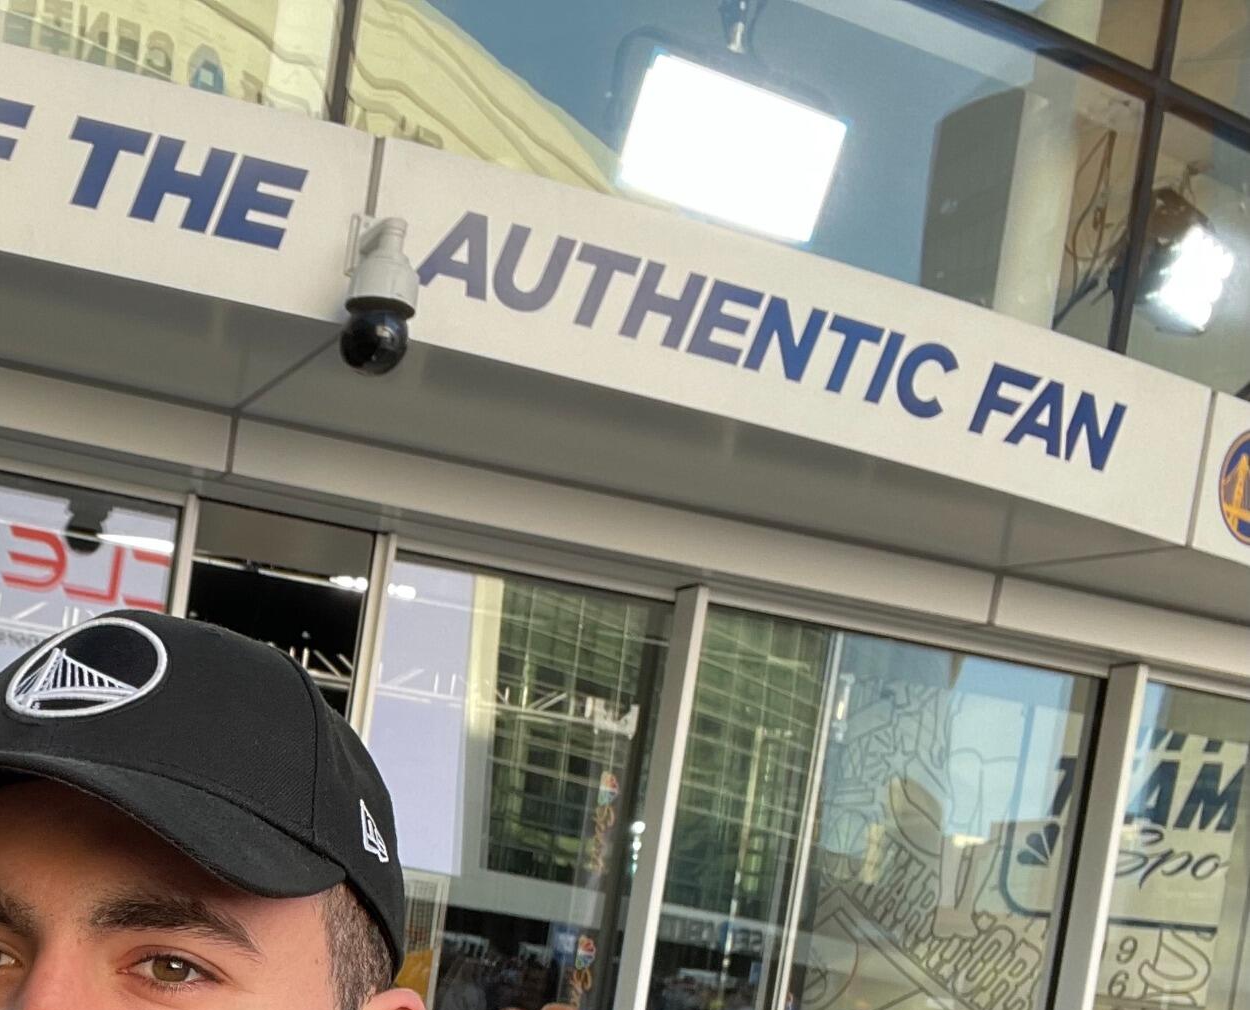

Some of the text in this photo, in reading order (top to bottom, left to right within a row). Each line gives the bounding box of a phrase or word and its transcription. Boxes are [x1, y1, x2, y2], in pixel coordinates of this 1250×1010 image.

[69, 116, 310, 251] THE
[416, 211, 960, 420] AUTHENTIC
[967, 362, 1128, 472] FAN
